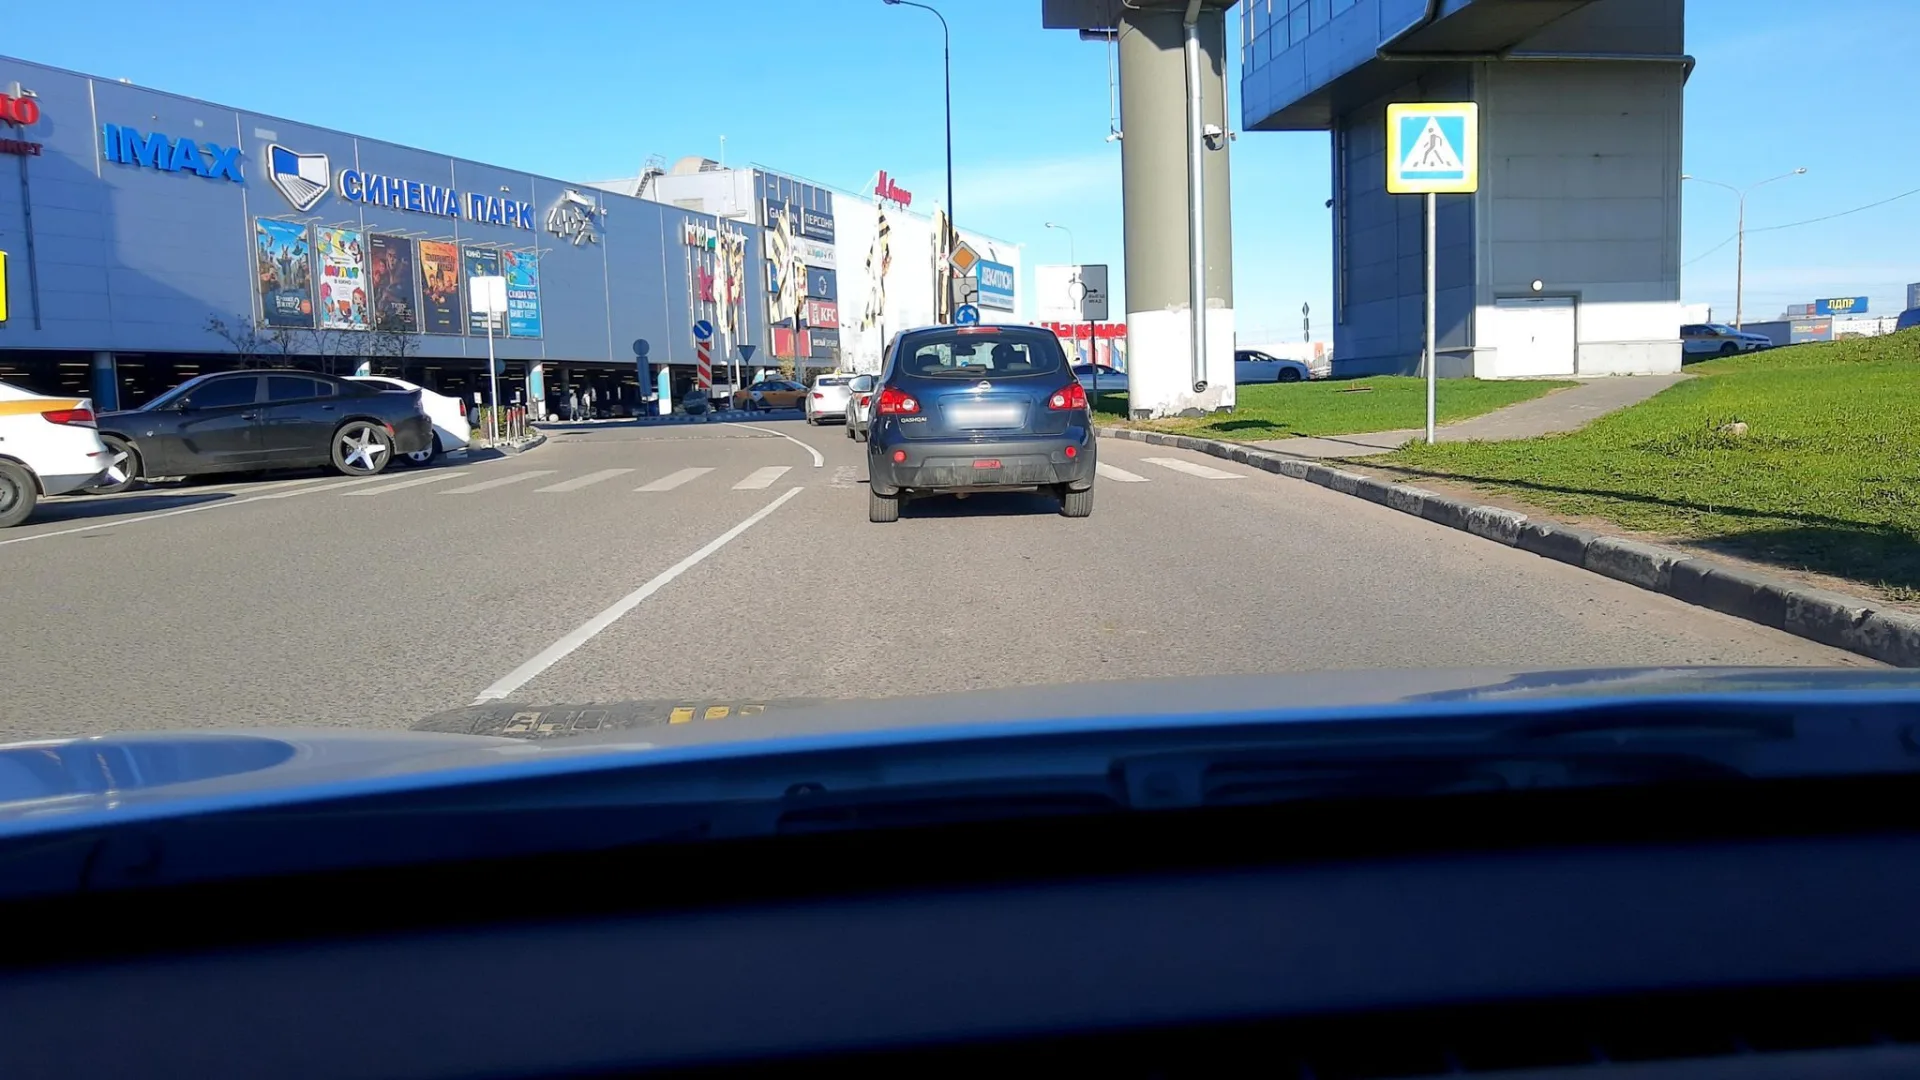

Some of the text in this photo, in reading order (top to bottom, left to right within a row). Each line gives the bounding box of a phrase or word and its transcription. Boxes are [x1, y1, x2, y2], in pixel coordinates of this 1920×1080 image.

[103, 123, 244, 182] IMAX
[340, 169, 537, 230] СИНЕМА ПАРК
[324, 264, 360, 280] МУЛЬТ
[1827, 299, 1855, 310] ЛДПР
[820, 307, 837, 322] KFC
[900, 416, 928, 424] QASHQAI
